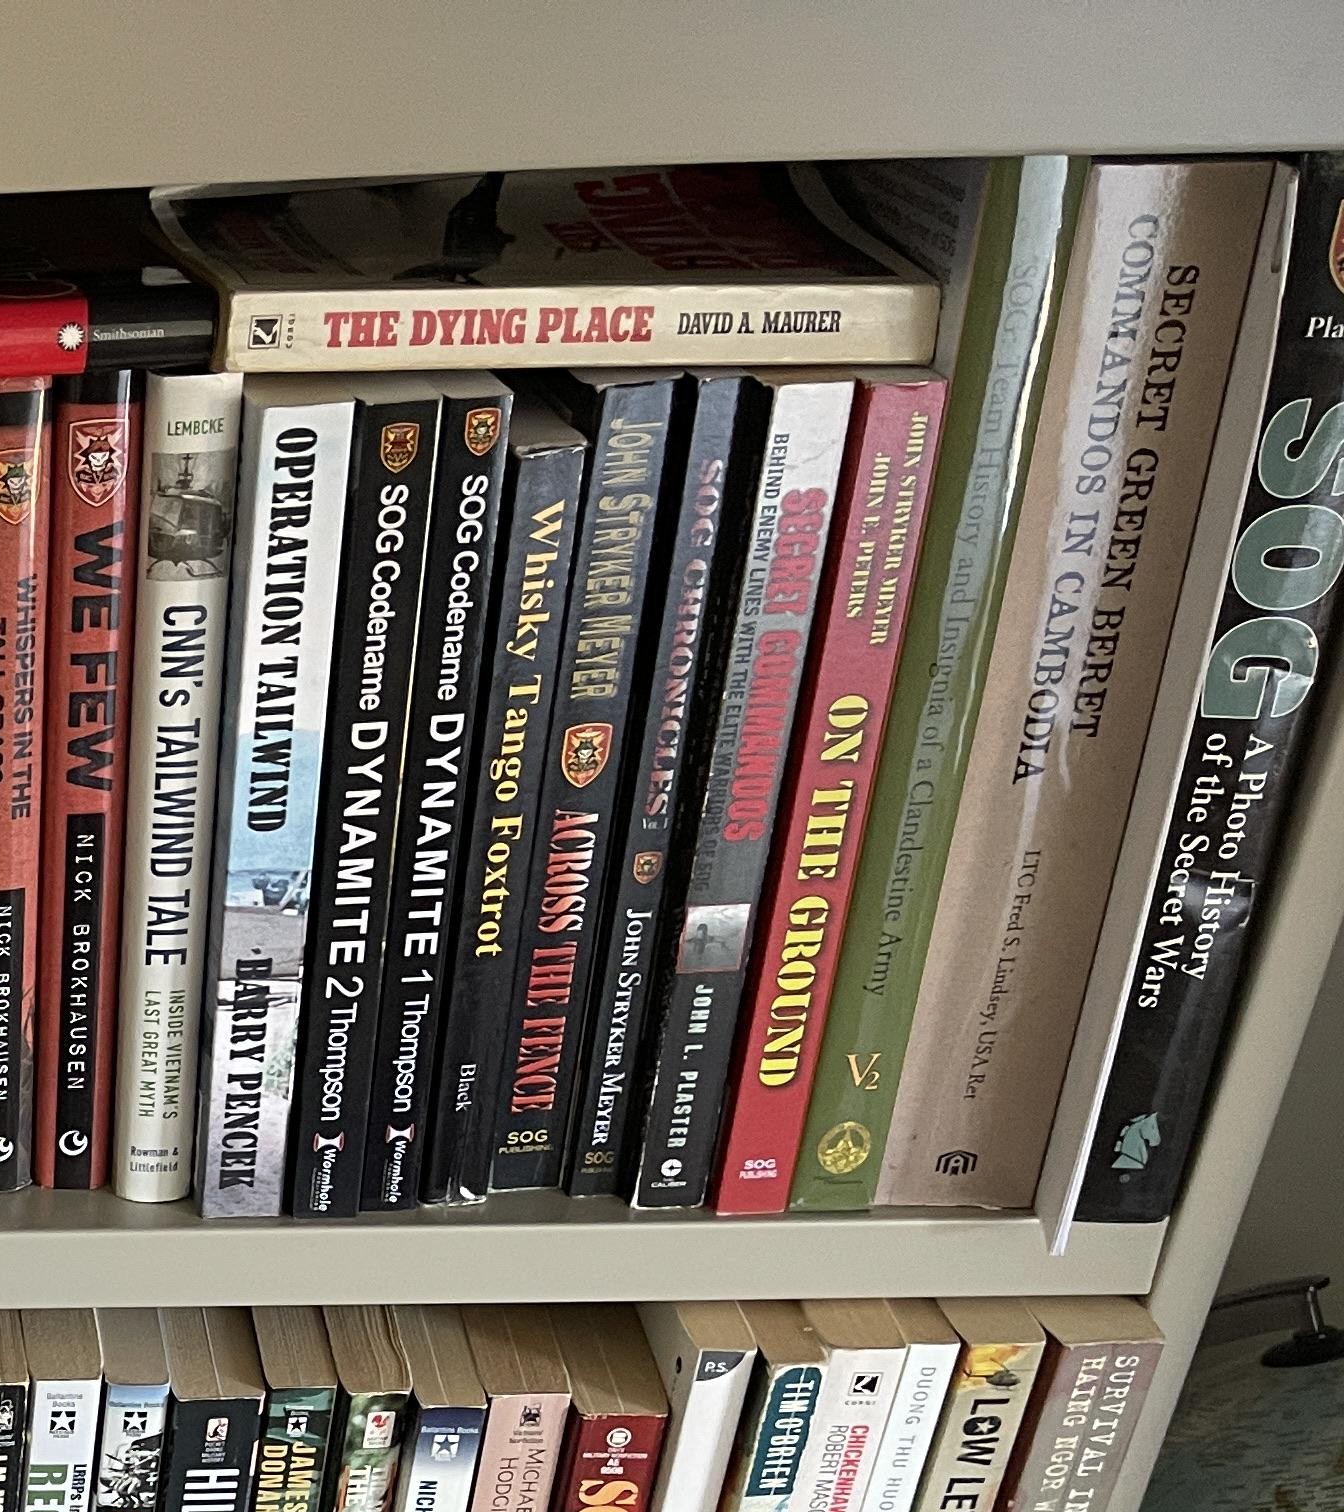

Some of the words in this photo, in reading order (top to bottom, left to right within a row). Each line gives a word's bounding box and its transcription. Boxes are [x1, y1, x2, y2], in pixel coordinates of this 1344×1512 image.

[92, 325, 166, 343] Smithsonian
[323, 310, 400, 349] THE
[410, 308, 528, 346] DYING
[534, 305, 656, 344] PLACE
[677, 311, 733, 335] DAVID
[736, 312, 754, 334] A.
[762, 310, 841, 334] MAURER
[1135, 264, 1200, 432] SECRET
[167, 418, 224, 436] LEMBCKE
[260, 426, 318, 646] OPERATION
[376, 484, 408, 554] SOG
[1100, 447, 1159, 591] GREEN
[360, 558, 401, 712] Codename
[1071, 605, 1127, 738] BERET
[328, 722, 389, 968] DYNAMITE
[325, 974, 364, 1000] 2
[318, 1002, 357, 1122] Thompson
